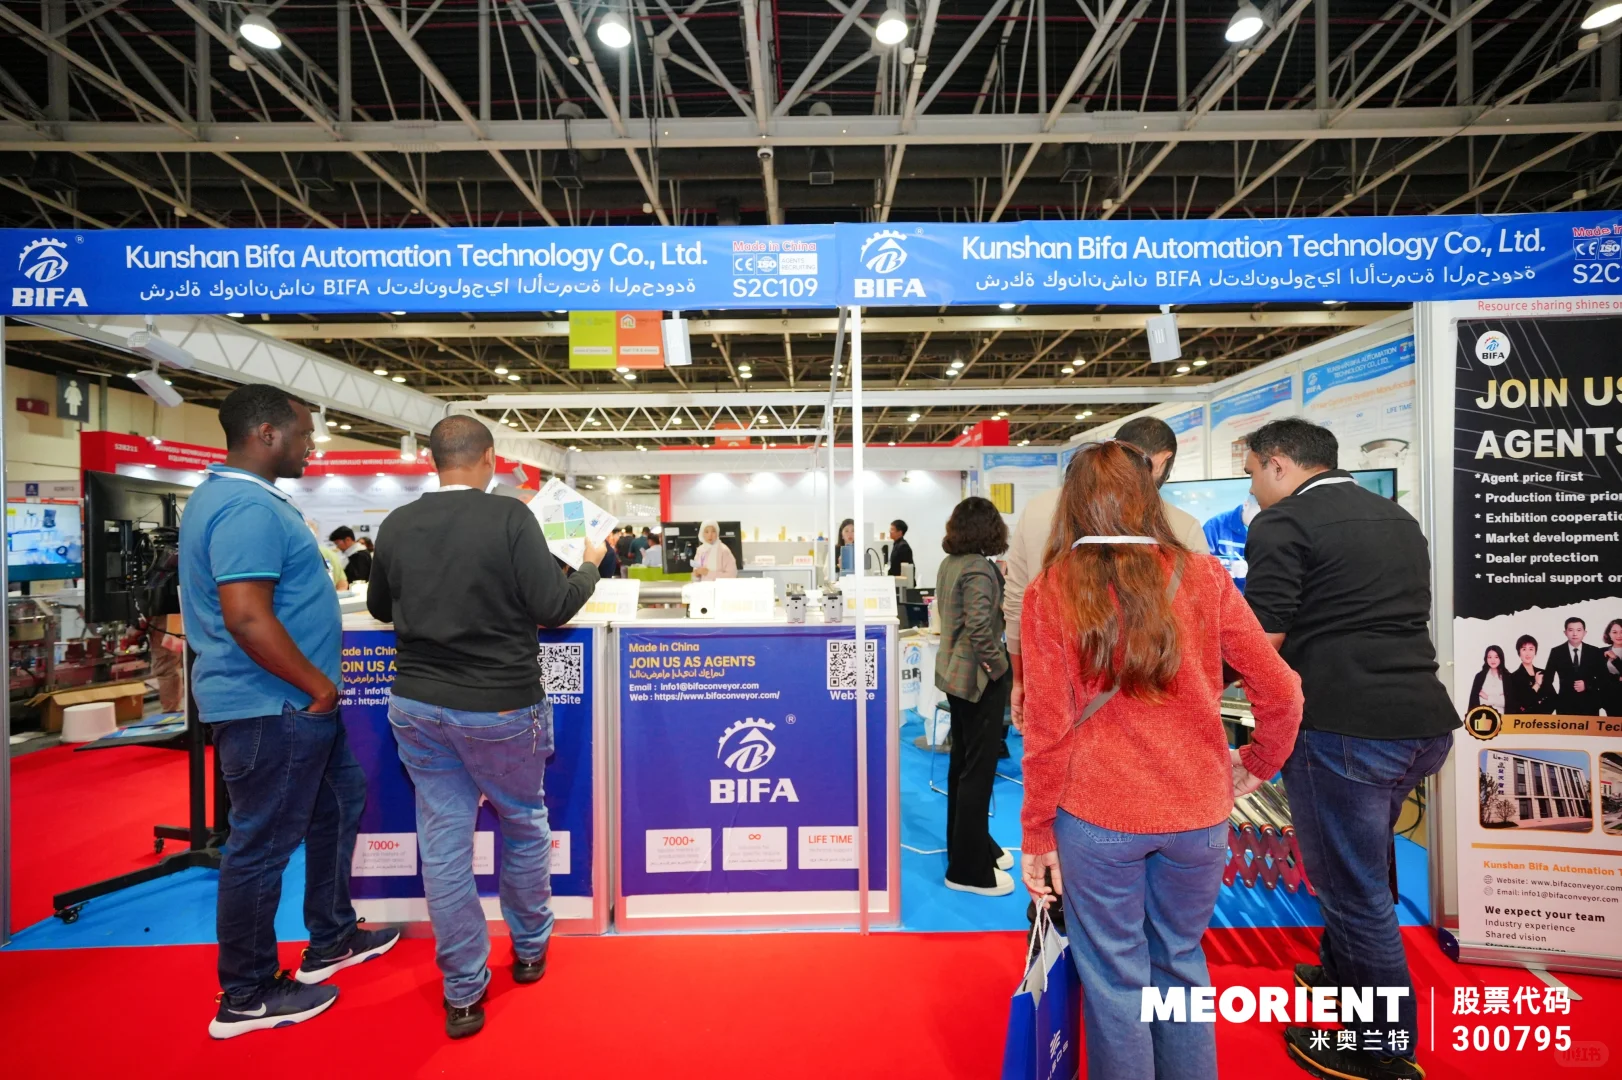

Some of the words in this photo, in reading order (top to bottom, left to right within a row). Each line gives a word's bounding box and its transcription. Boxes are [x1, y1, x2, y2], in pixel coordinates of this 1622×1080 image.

[1572, 226, 1611, 238] Made
[733, 241, 766, 252] Made
[769, 241, 780, 251] in
[782, 240, 817, 251] China
[962, 236, 1072, 260] Kunshan
[1078, 235, 1127, 260] Bifa
[1132, 234, 1282, 260] Automation
[1288, 232, 1438, 261] Technology
[1444, 231, 1492, 257] Co.,
[1499, 228, 1546, 253] Ltd.
[126, 244, 239, 270] Kunshan
[246, 244, 296, 269] Bifa
[301, 243, 451, 269] Automation
[457, 242, 603, 272] Technology
[609, 242, 656, 270] Co.,
[662, 241, 708, 265] Ltd.
[1156, 270, 1201, 287] BIFA
[323, 279, 370, 296] BIFA
[733, 277, 818, 298] S2C109
[854, 278, 926, 298] BIFA
[12, 287, 88, 307] BIFA
[1478, 301, 1528, 311] Resource
[1532, 300, 1573, 312] sharing
[1576, 300, 1610, 310] shines
[1482, 352, 1505, 360] BIFA
[1475, 378, 1568, 409] JOIN
[1584, 376, 1622, 406] U
[1474, 427, 1622, 459] AGENT
[1522, 472, 1552, 484] price
[1555, 471, 1584, 482] first
[1485, 492, 1552, 503] Production
[1555, 492, 1585, 502] time
[1485, 512, 1548, 523] Exhibition
[1485, 532, 1529, 543] Market
[1533, 531, 1619, 544] development
[1486, 553, 1527, 564] Dealer
[1530, 552, 1599, 565] protection
[1486, 572, 1546, 583] Technical
[1550, 572, 1603, 584] support
[342, 646, 361, 656] ade
[375, 646, 397, 656] Chin
[629, 643, 657, 653] Made
[671, 642, 700, 652] China
[342, 661, 364, 672] OIN
[367, 661, 385, 672] US
[388, 661, 398, 672] A
[629, 657, 660, 669] JOIN
[663, 656, 681, 668] US
[684, 656, 701, 668] AS
[704, 655, 756, 668] AGENTS
[629, 683, 652, 692] Email
[338, 698, 353, 706] eb
[630, 693, 648, 701] Web
[1514, 719, 1589, 731] Professional
[710, 778, 799, 803] BIFA
[367, 840, 401, 851] 7000+
[663, 836, 695, 847] 7000+
[808, 834, 828, 844] LIFE
[831, 834, 853, 844] TIME
[1484, 861, 1525, 870] Kunshan
[1528, 862, 1549, 871] Bifa
[1553, 864, 1615, 876] Automation
[1496, 877, 1529, 885] Website:
[1531, 879, 1622, 892] www.bifaconveyor.com
[1497, 888, 1520, 896] Email:
[1521, 890, 1619, 903] info1@bifaconveyor.com
[1485, 906, 1501, 914] We
[1504, 907, 1541, 918] expect
[1545, 910, 1572, 920] your
[1575, 913, 1606, 922] team
[1485, 919, 1522, 929] Industry
[1524, 920, 1576, 933] experience
[1485, 930, 1516, 940] Shared
[1519, 933, 1547, 942] vision
